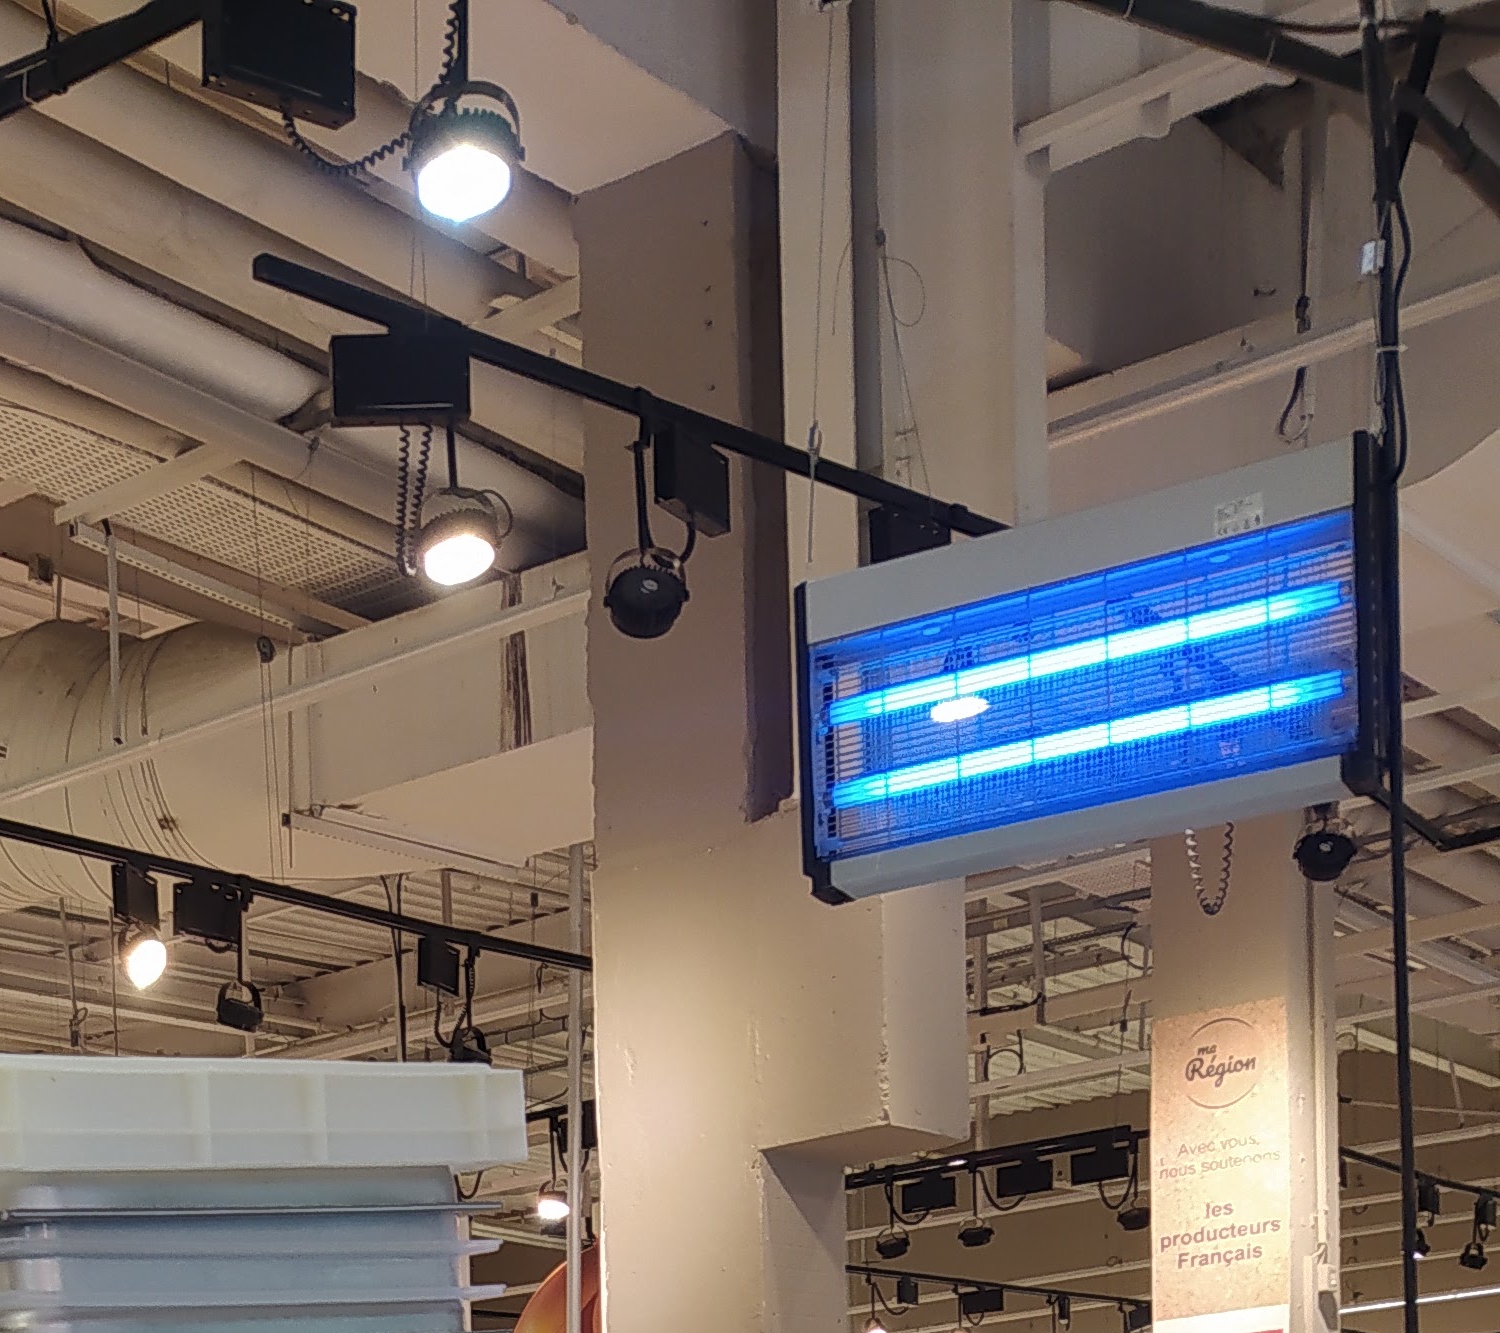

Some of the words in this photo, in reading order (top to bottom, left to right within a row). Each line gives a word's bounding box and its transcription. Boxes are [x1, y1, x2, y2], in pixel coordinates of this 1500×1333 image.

[1197, 1044, 1217, 1056] ma
[1185, 1055, 1257, 1088] Région
[1178, 1142, 1215, 1158] Avec
[1159, 1166, 1197, 1180] nous
[1201, 1150, 1281, 1172] soutenons
[1205, 1202, 1234, 1219] les
[1160, 1218, 1282, 1252] producteurs
[1177, 1243, 1263, 1270] Français
